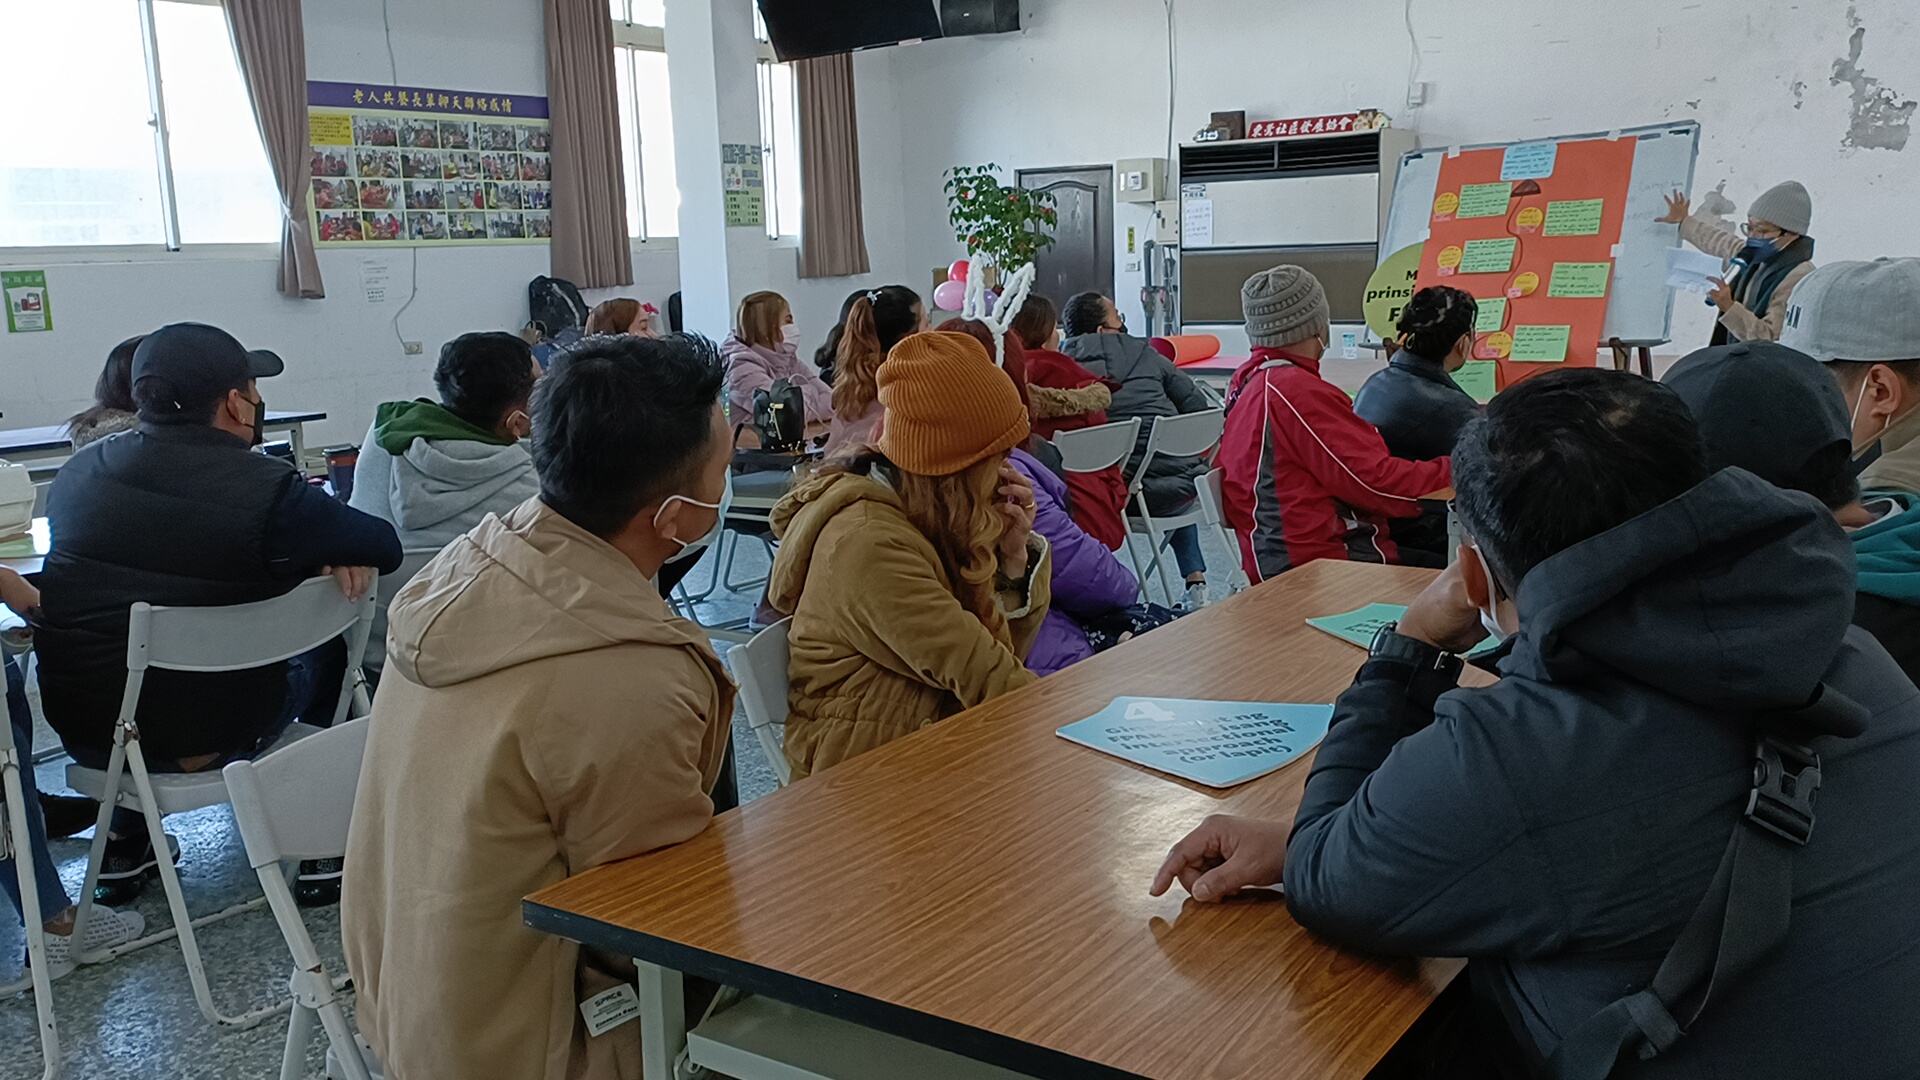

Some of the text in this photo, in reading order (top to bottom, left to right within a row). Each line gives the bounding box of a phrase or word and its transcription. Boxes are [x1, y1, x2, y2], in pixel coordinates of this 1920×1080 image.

[1218, 719, 1289, 731] isang
[1235, 712, 1269, 721] ng
[1120, 725, 1296, 750] intersectional
[1162, 737, 1283, 755] approach
[1180, 744, 1293, 764] (or lapit)
